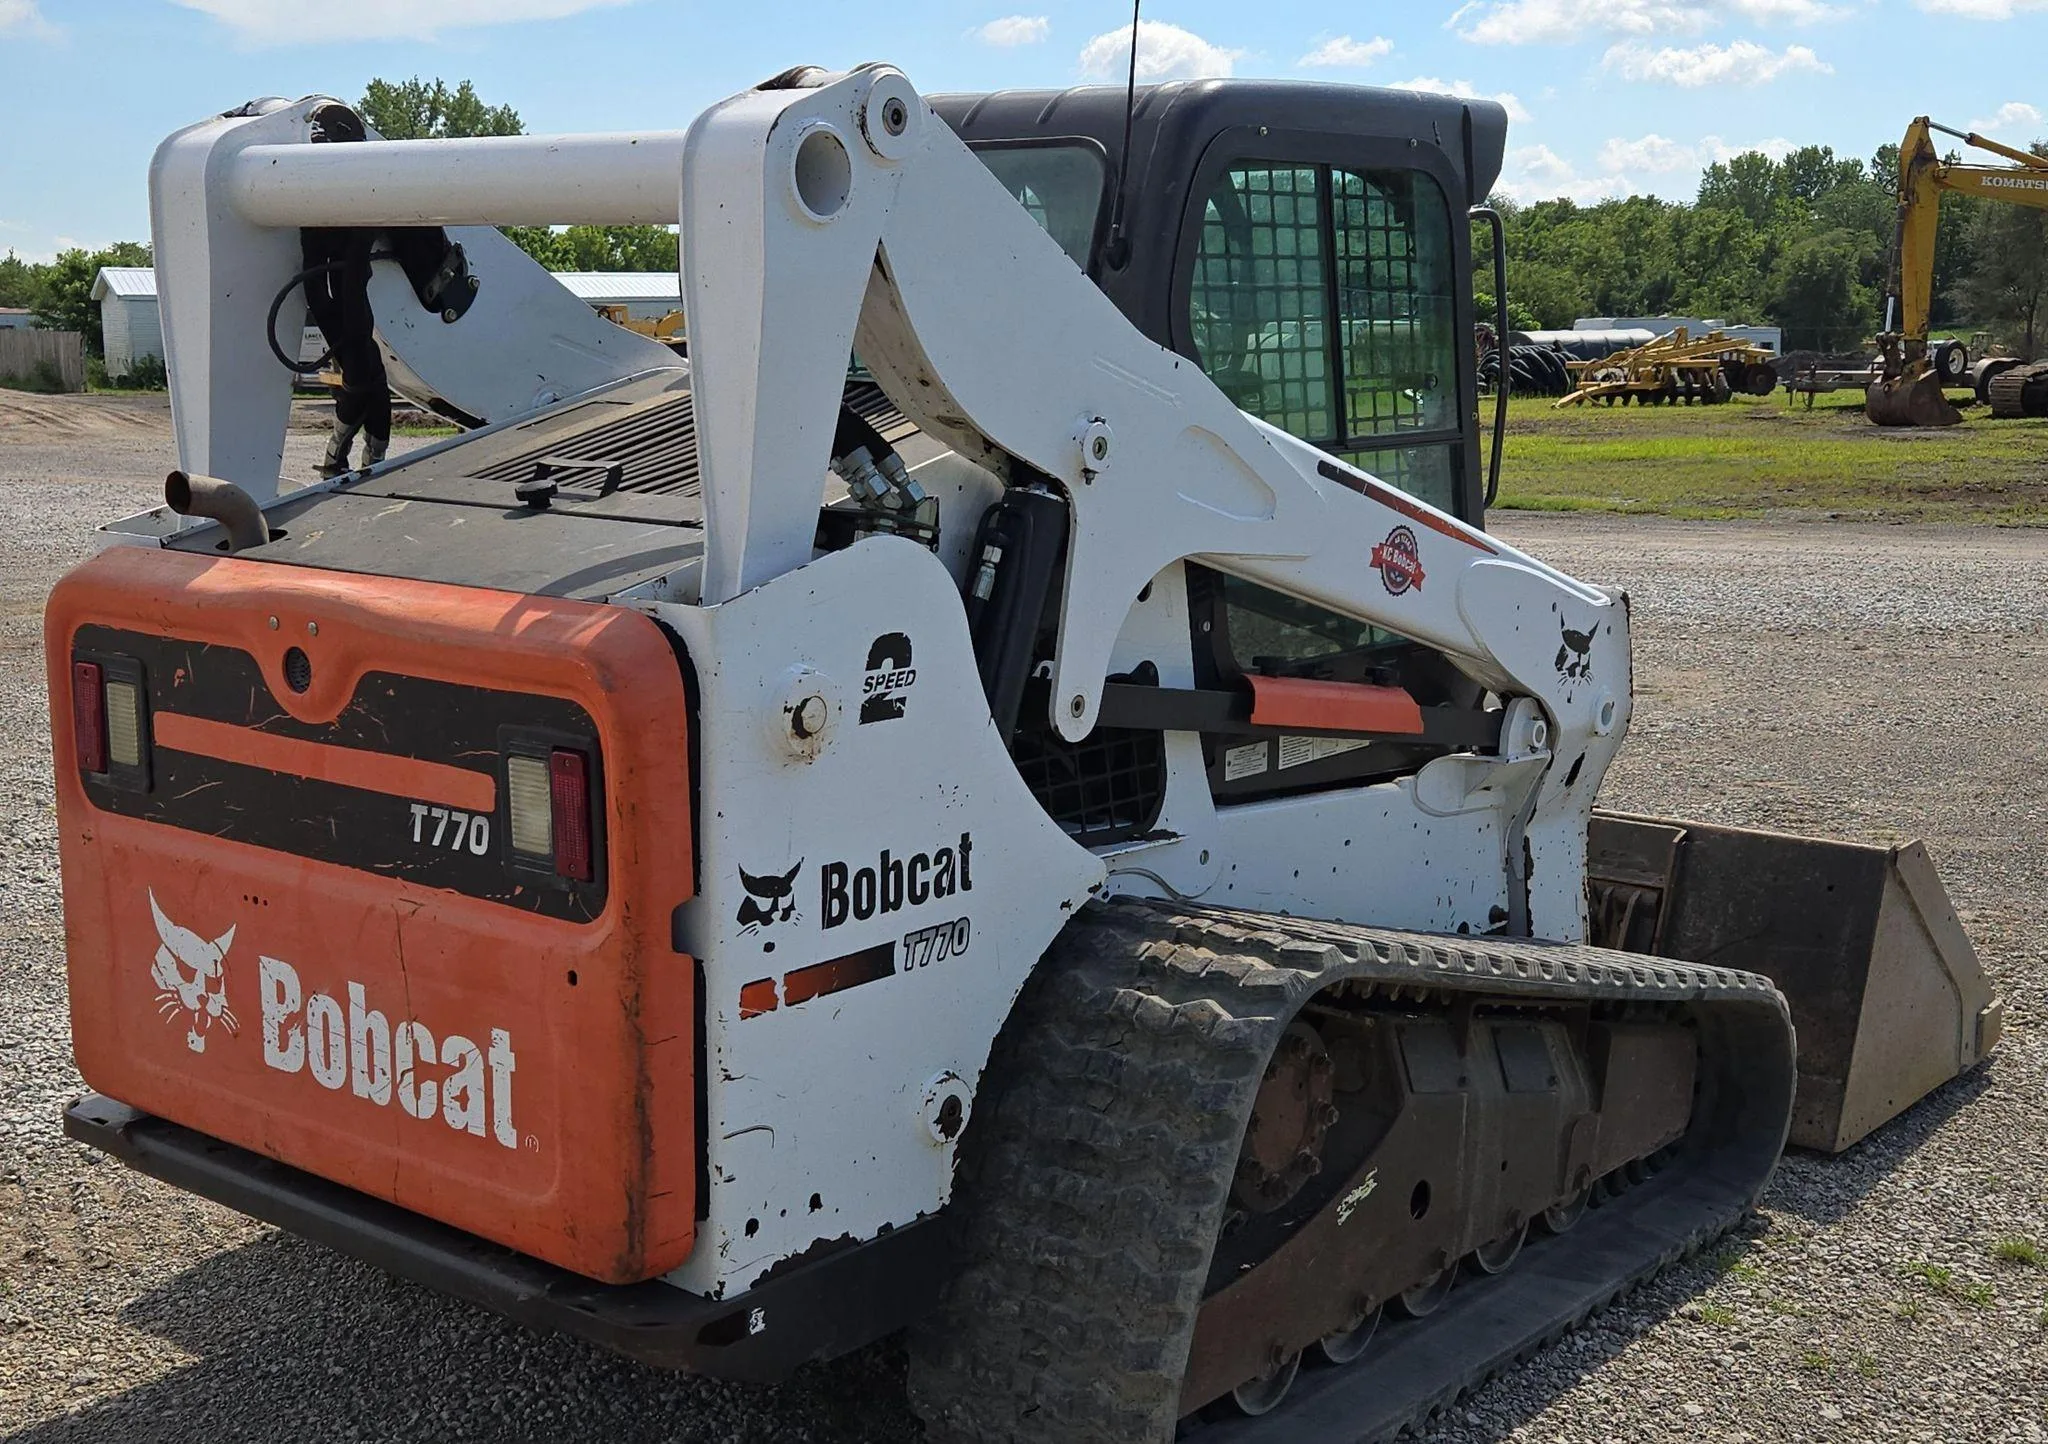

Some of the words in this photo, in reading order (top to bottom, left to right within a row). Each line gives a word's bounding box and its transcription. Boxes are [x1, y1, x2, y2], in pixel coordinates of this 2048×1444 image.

[1393, 549, 1417, 574] Bobcat
[862, 669, 917, 694] SPEED
[410, 803, 490, 855] T770
[822, 832, 973, 930] Bobcat
[903, 916, 971, 972] T770
[259, 955, 517, 1149] Bobcat
